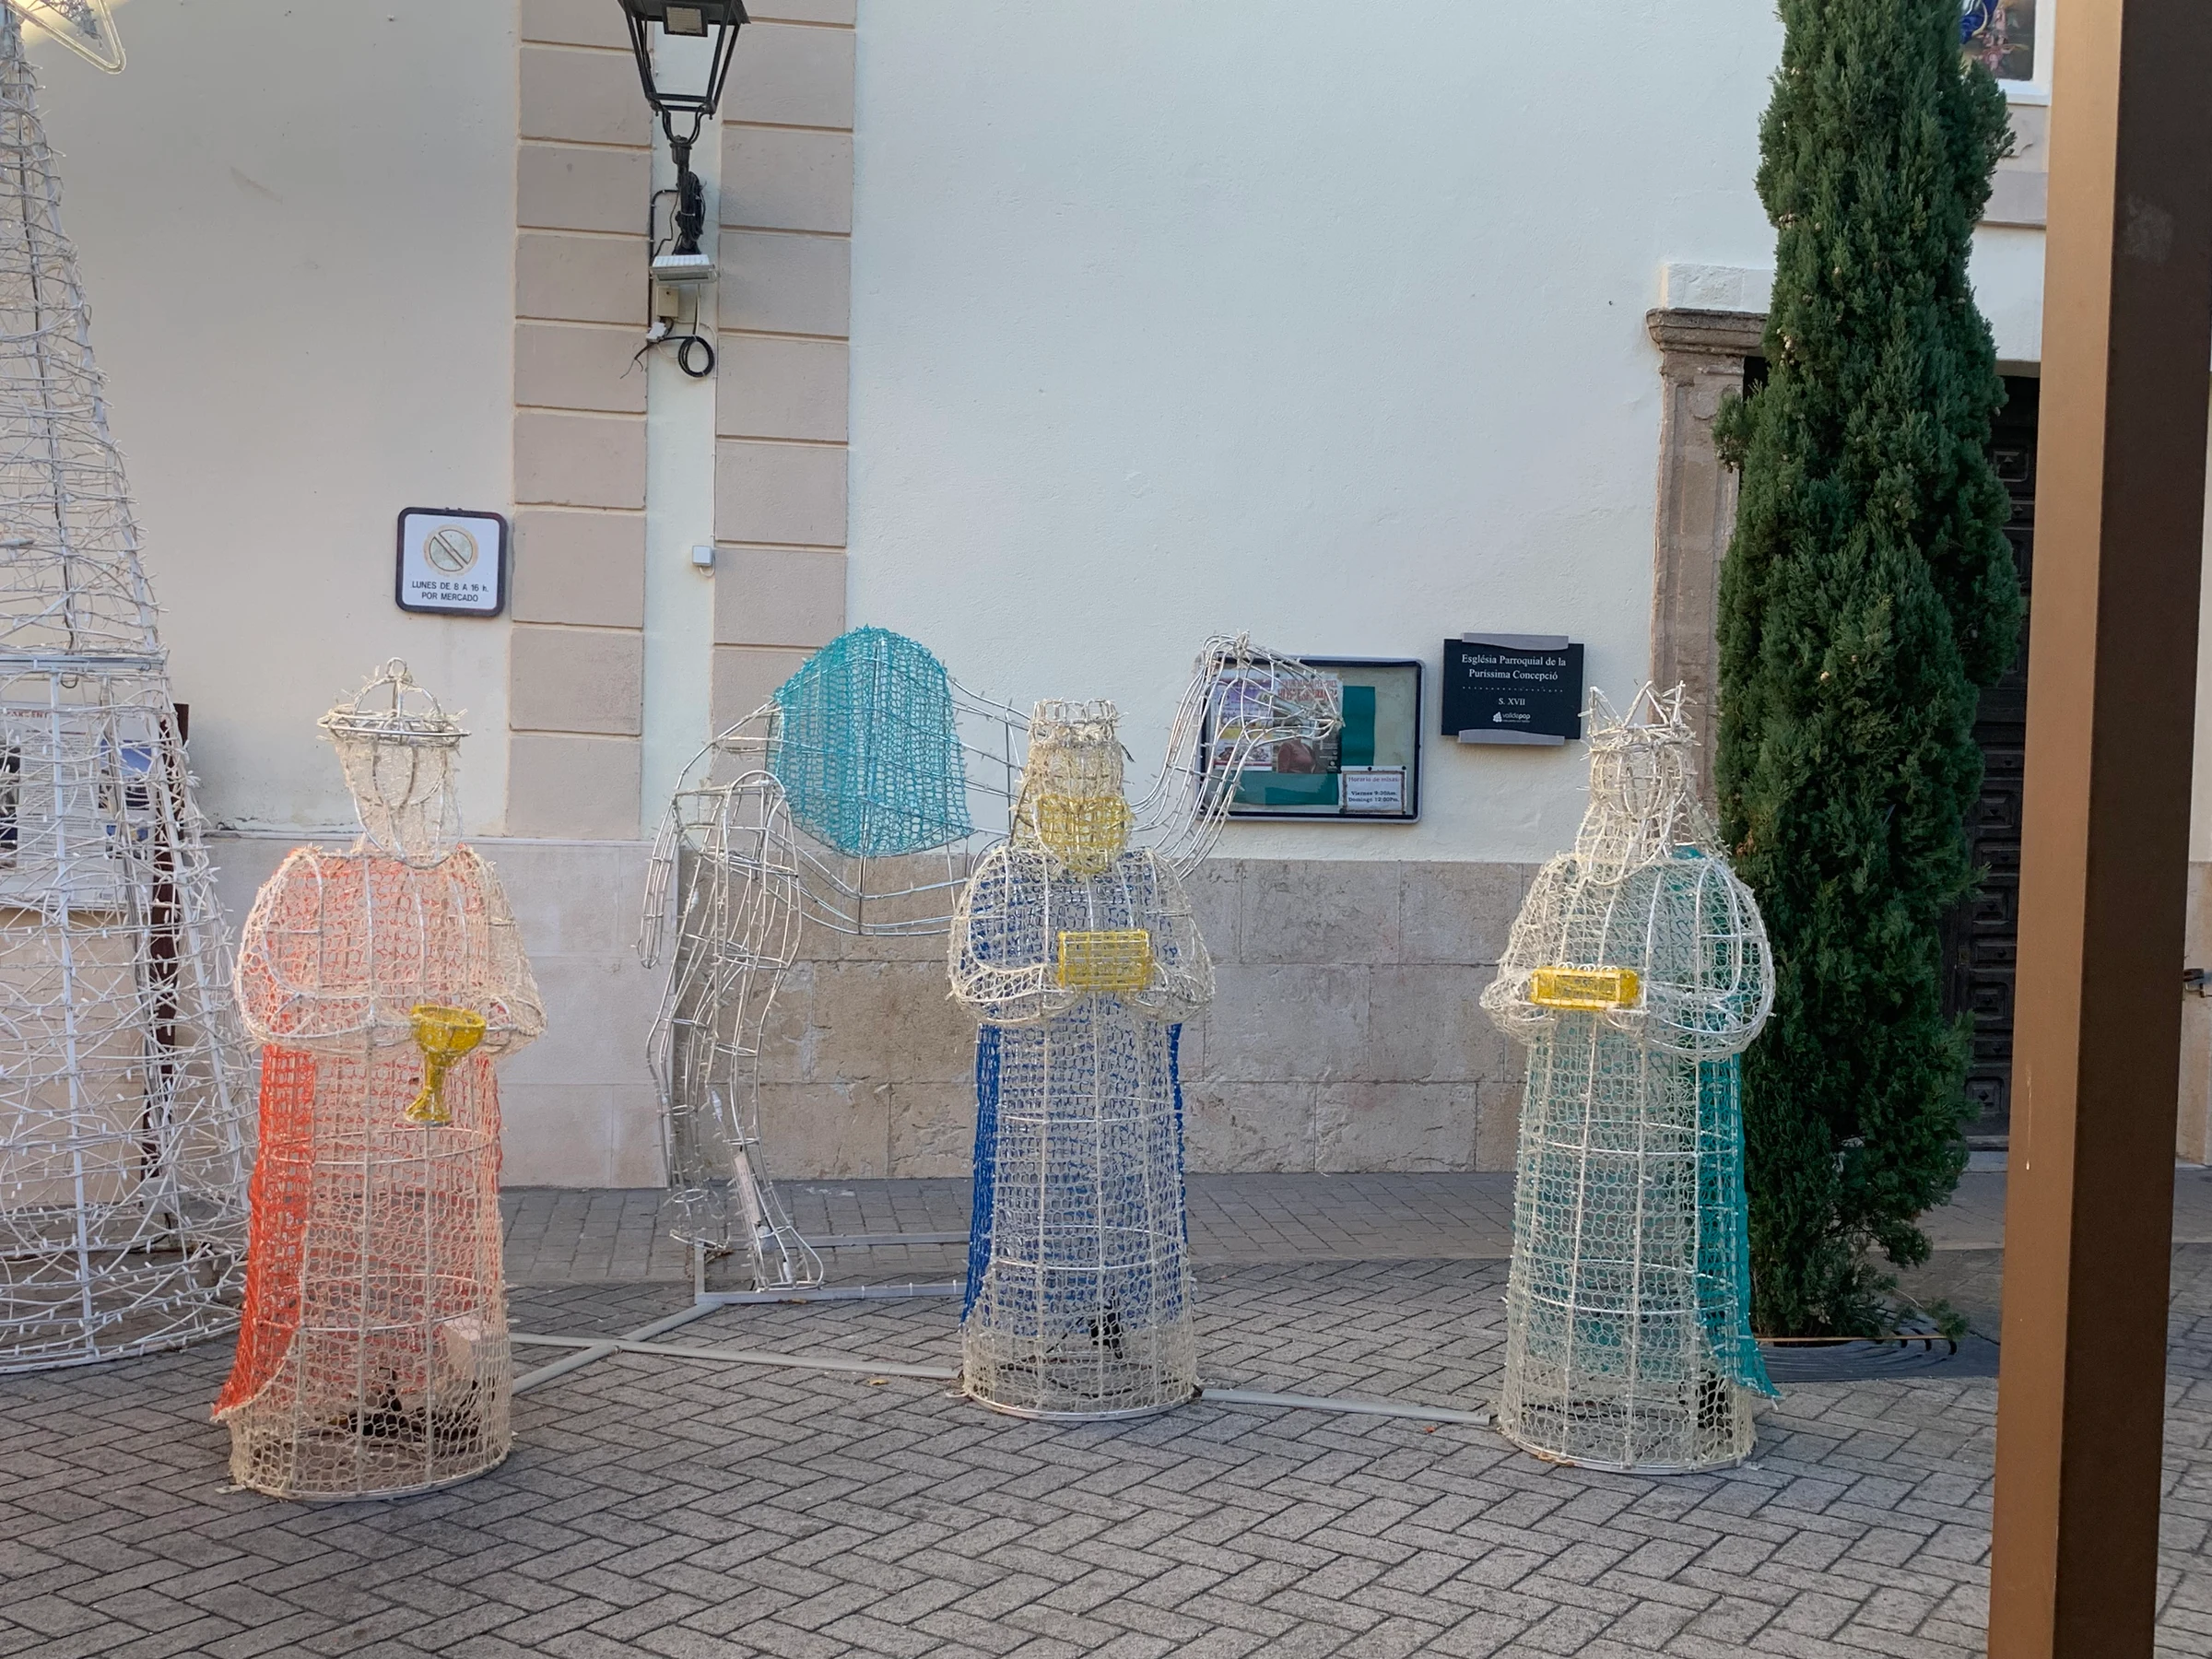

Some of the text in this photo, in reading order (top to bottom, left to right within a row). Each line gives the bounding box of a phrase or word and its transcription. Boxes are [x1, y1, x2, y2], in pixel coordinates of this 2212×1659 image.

[412, 581, 437, 590] LUNES
[440, 582, 451, 590] DE
[453, 582, 460, 591] 8
[462, 583, 468, 592] A
[471, 583, 479, 592] 16
[421, 592, 478, 602] POR MERCADO
[1462, 653, 1566, 667] Església Parroquial de la
[1468, 669, 1559, 682] Puríssima Concepció
[1507, 698, 1526, 706] XVII
